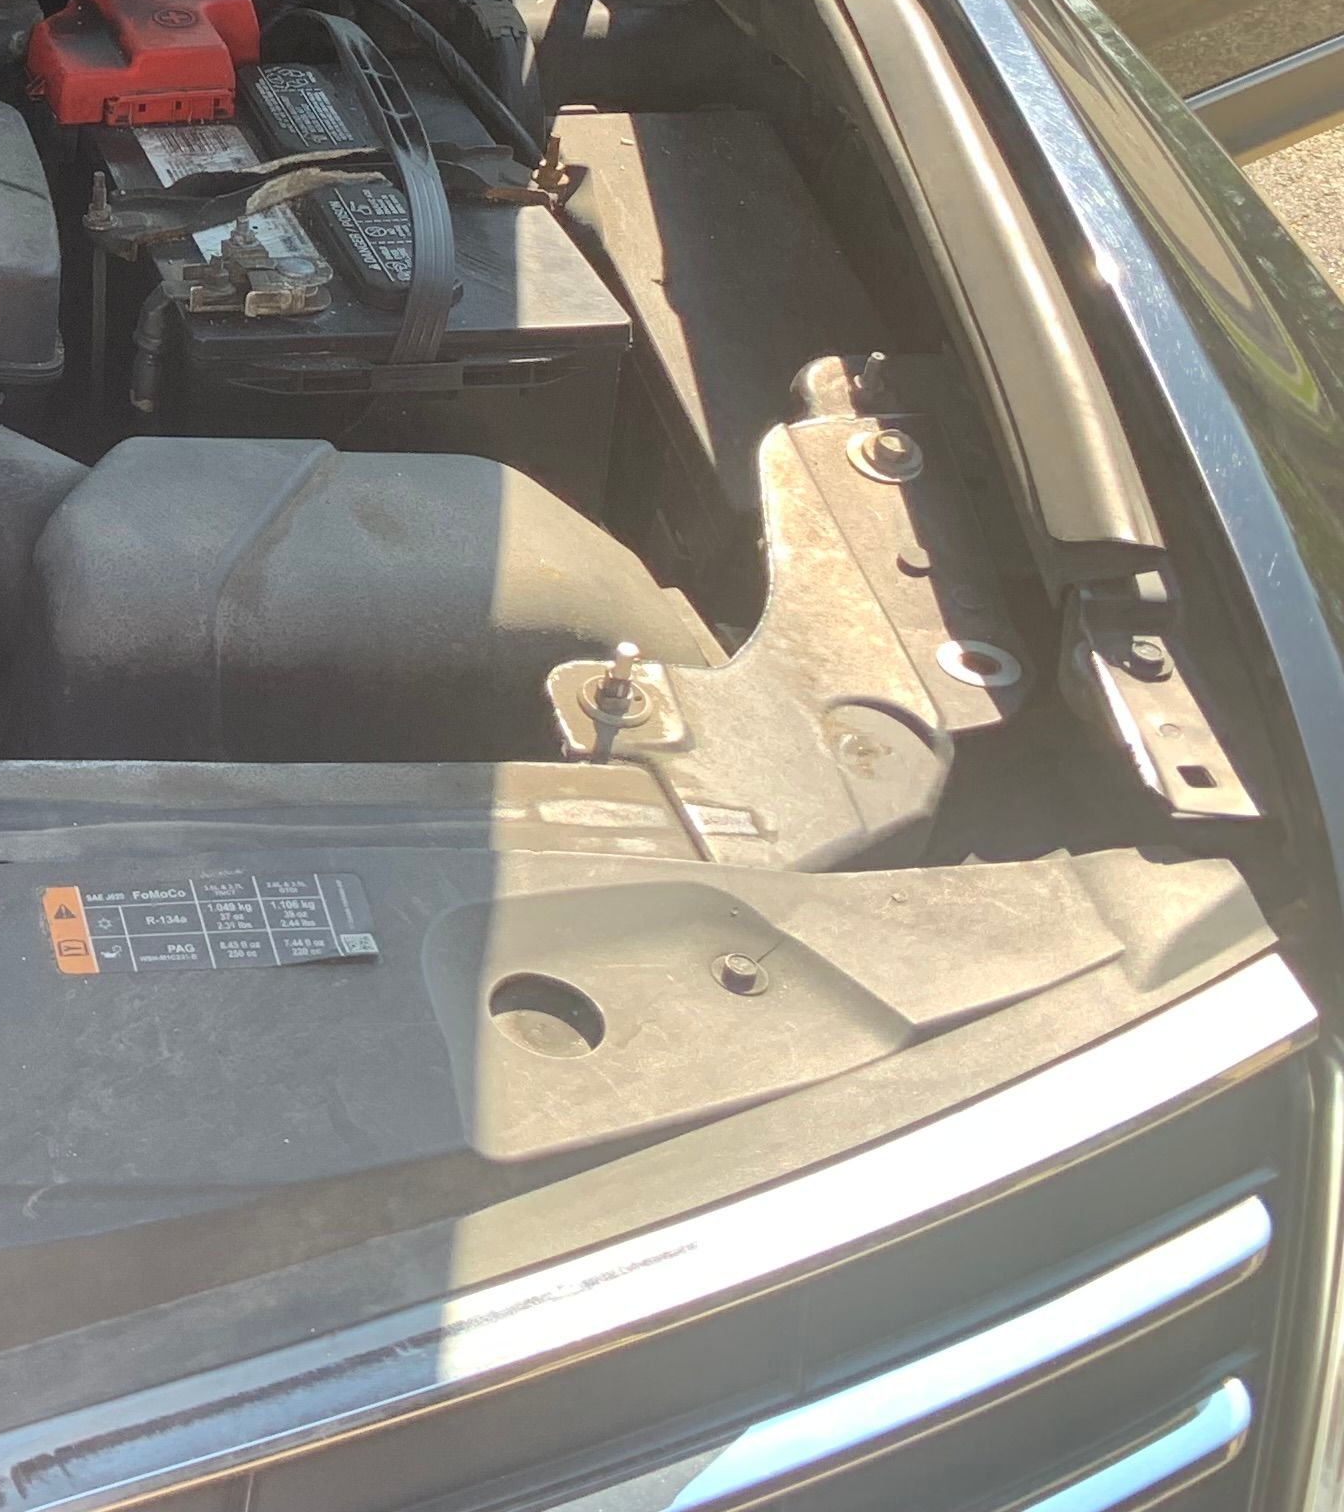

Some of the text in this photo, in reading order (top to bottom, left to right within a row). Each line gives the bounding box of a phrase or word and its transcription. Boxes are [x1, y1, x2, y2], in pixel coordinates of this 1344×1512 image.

[132, 889, 186, 900] FoMoCo
[145, 915, 188, 925] R-134a
[167, 943, 196, 954] PAG
